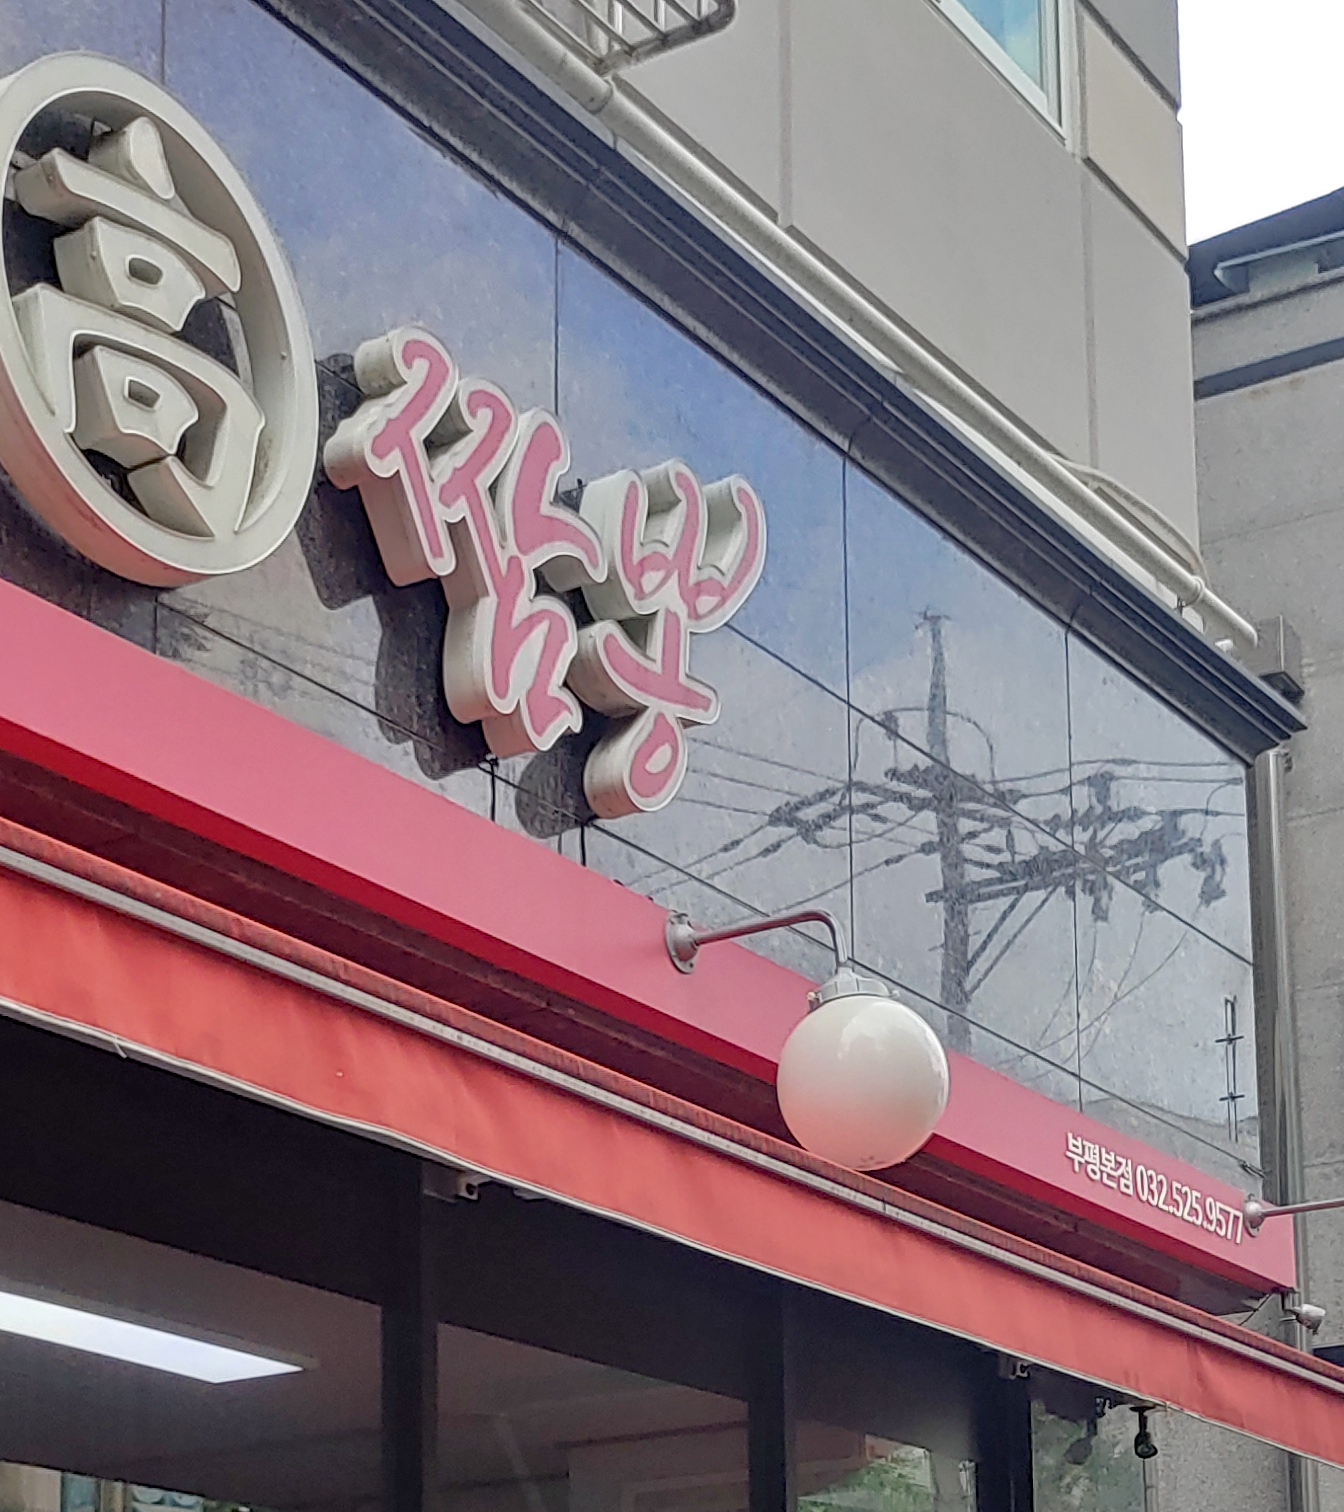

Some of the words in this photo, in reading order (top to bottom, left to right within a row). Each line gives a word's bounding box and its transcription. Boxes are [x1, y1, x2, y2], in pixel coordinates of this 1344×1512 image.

[2, 112, 268, 545] 高
[324, 325, 768, 816] 짬뽕
[1065, 1132, 1134, 1196] 부평본점
[1135, 1165, 1244, 1245] 032.525.9577
